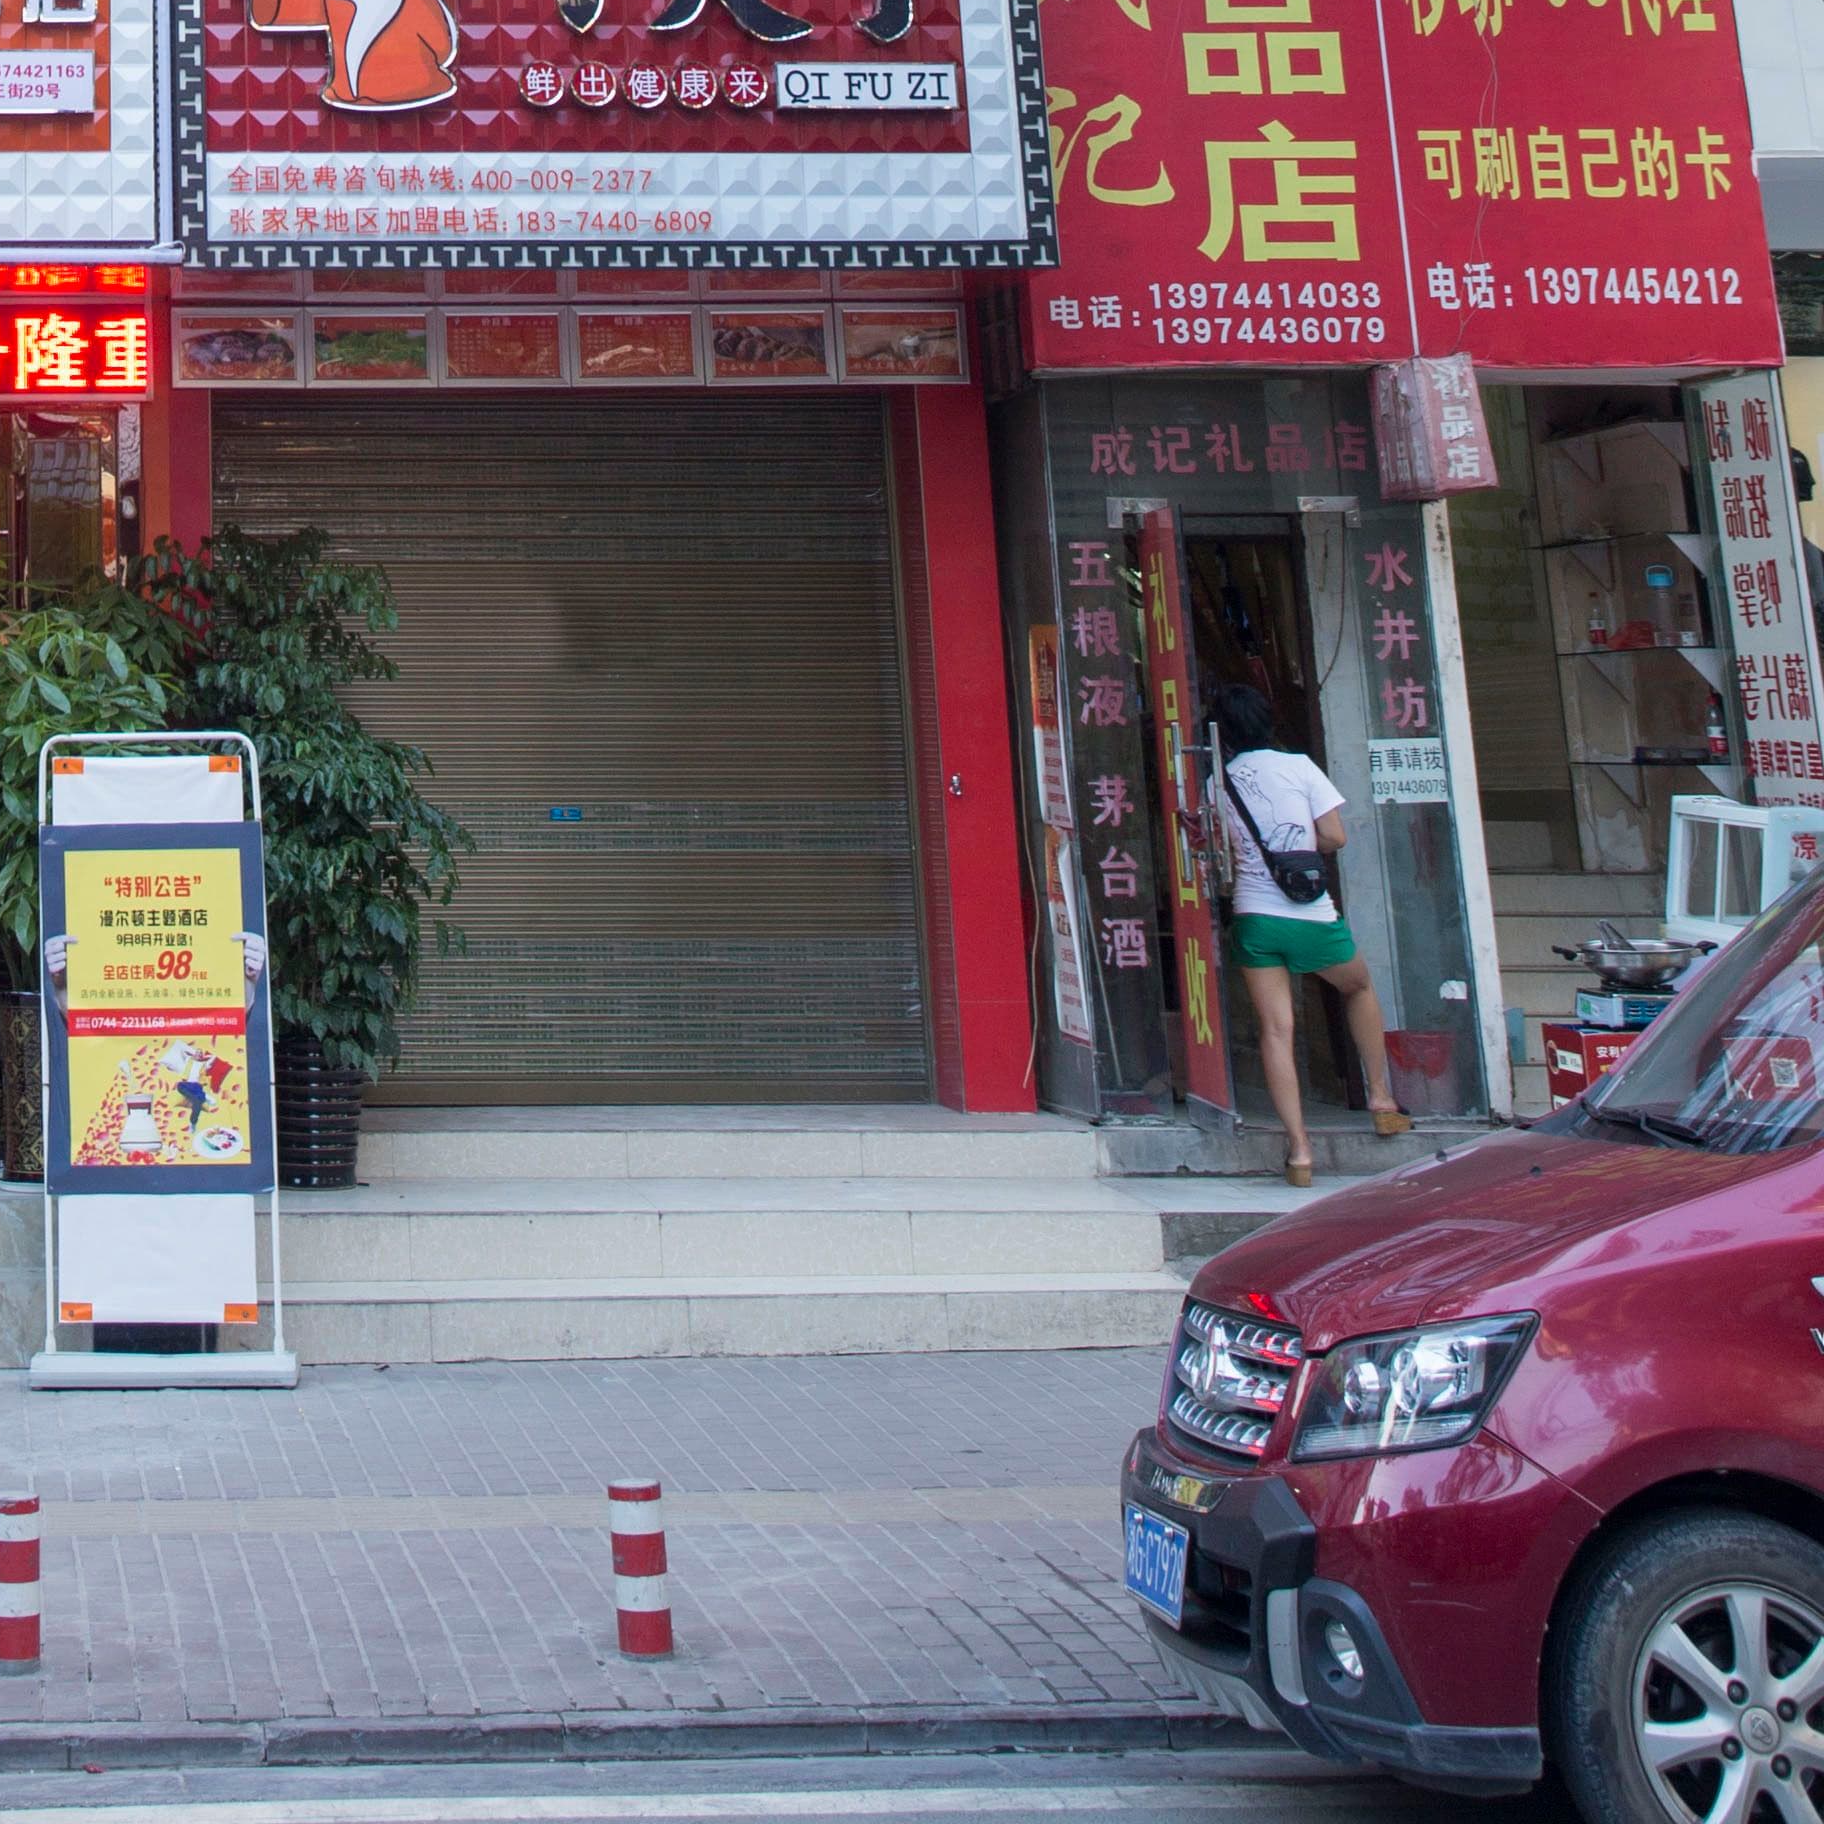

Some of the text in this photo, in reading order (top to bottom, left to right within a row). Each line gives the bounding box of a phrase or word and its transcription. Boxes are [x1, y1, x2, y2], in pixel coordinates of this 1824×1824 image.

[523, 66, 765, 102] 鲜出健康来
[784, 69, 953, 104] QI FU ZI
[1417, 126, 1733, 205] 可刷自己的卡
[1148, 282, 1382, 311] 13974414033
[1152, 315, 1386, 345] 13974436079
[1090, 420, 1368, 476] 成记礼品店
[1068, 540, 1128, 727] 五粮液
[1364, 541, 1430, 730] 水井坊
[1368, 746, 1444, 773] 有事请拨
[1370, 778, 1448, 795] 13974436079
[1087, 773, 1149, 969] 茅台酒
[99, 908, 209, 928] 漫尔顿主题酒店
[90, 1015, 166, 1029] 0744-2211168
